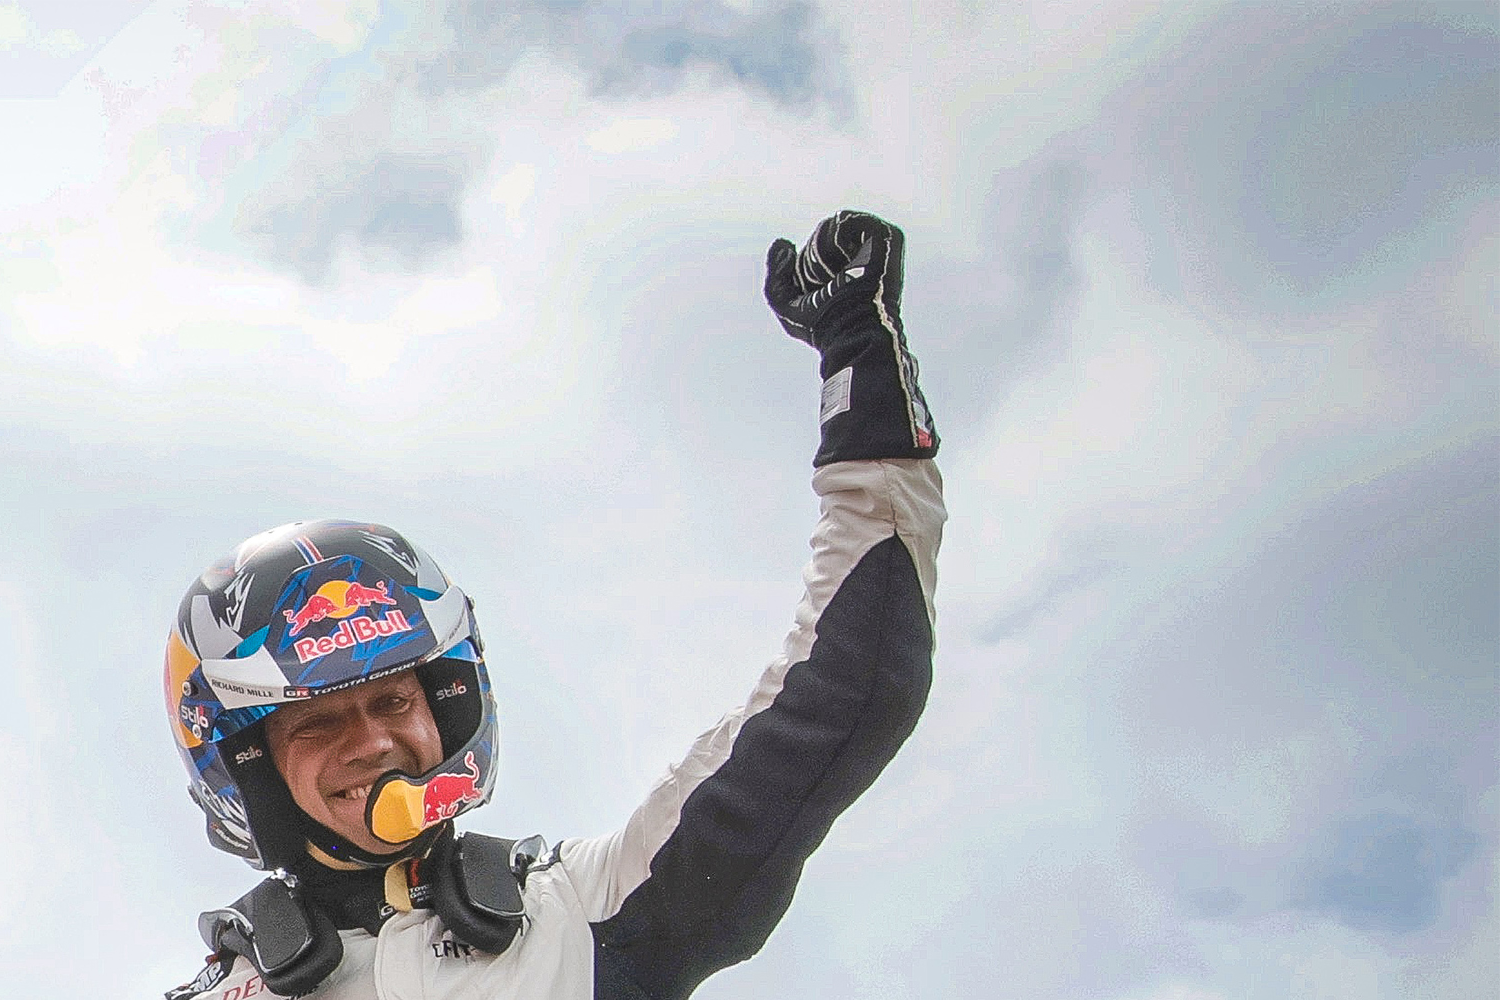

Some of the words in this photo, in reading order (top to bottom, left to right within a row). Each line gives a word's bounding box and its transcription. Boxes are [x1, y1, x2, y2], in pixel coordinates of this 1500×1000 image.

[294, 620, 357, 664] Red
[352, 610, 412, 643] Bull
[211, 679, 244, 695] RICHARD
[246, 689, 274, 698] MILLE
[311, 677, 366, 696] TOYOTA
